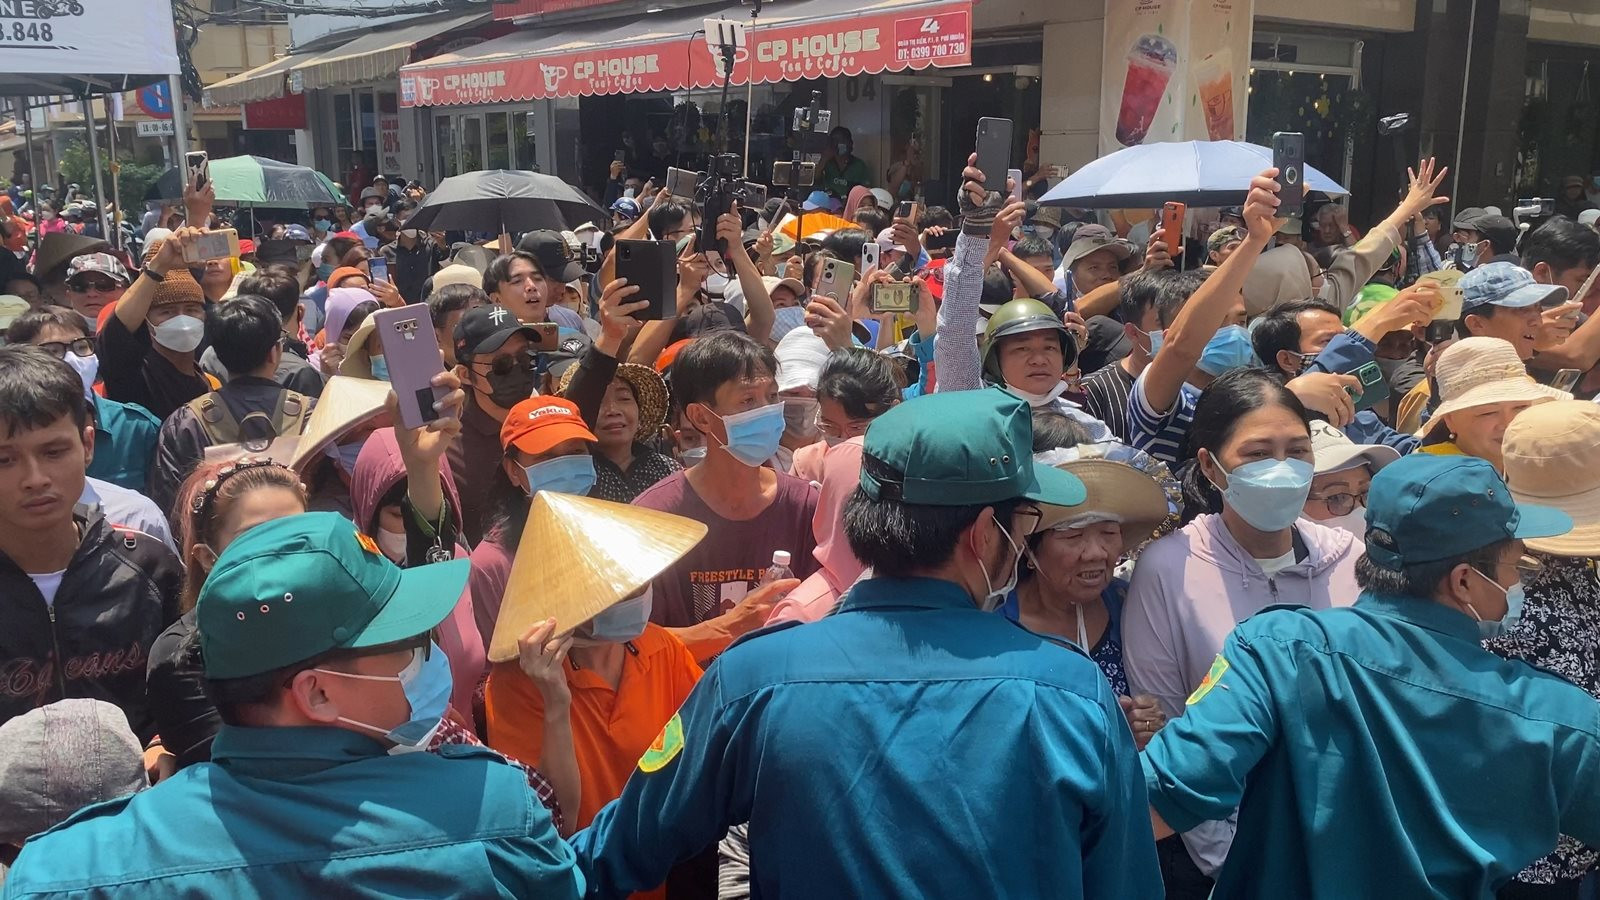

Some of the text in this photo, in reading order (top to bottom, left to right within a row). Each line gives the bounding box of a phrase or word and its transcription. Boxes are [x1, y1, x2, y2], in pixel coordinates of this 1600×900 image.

[920, 17, 940, 34] 4
[757, 27, 881, 62] CP HOUSE
[911, 45, 930, 59] 0399
[932, 44, 947, 57] 700
[949, 42, 965, 55] 730
[573, 54, 660, 80] CP HOUSE
[443, 70, 506, 90] CP HOUSE
[690, 569, 754, 583] FREESTYLE
